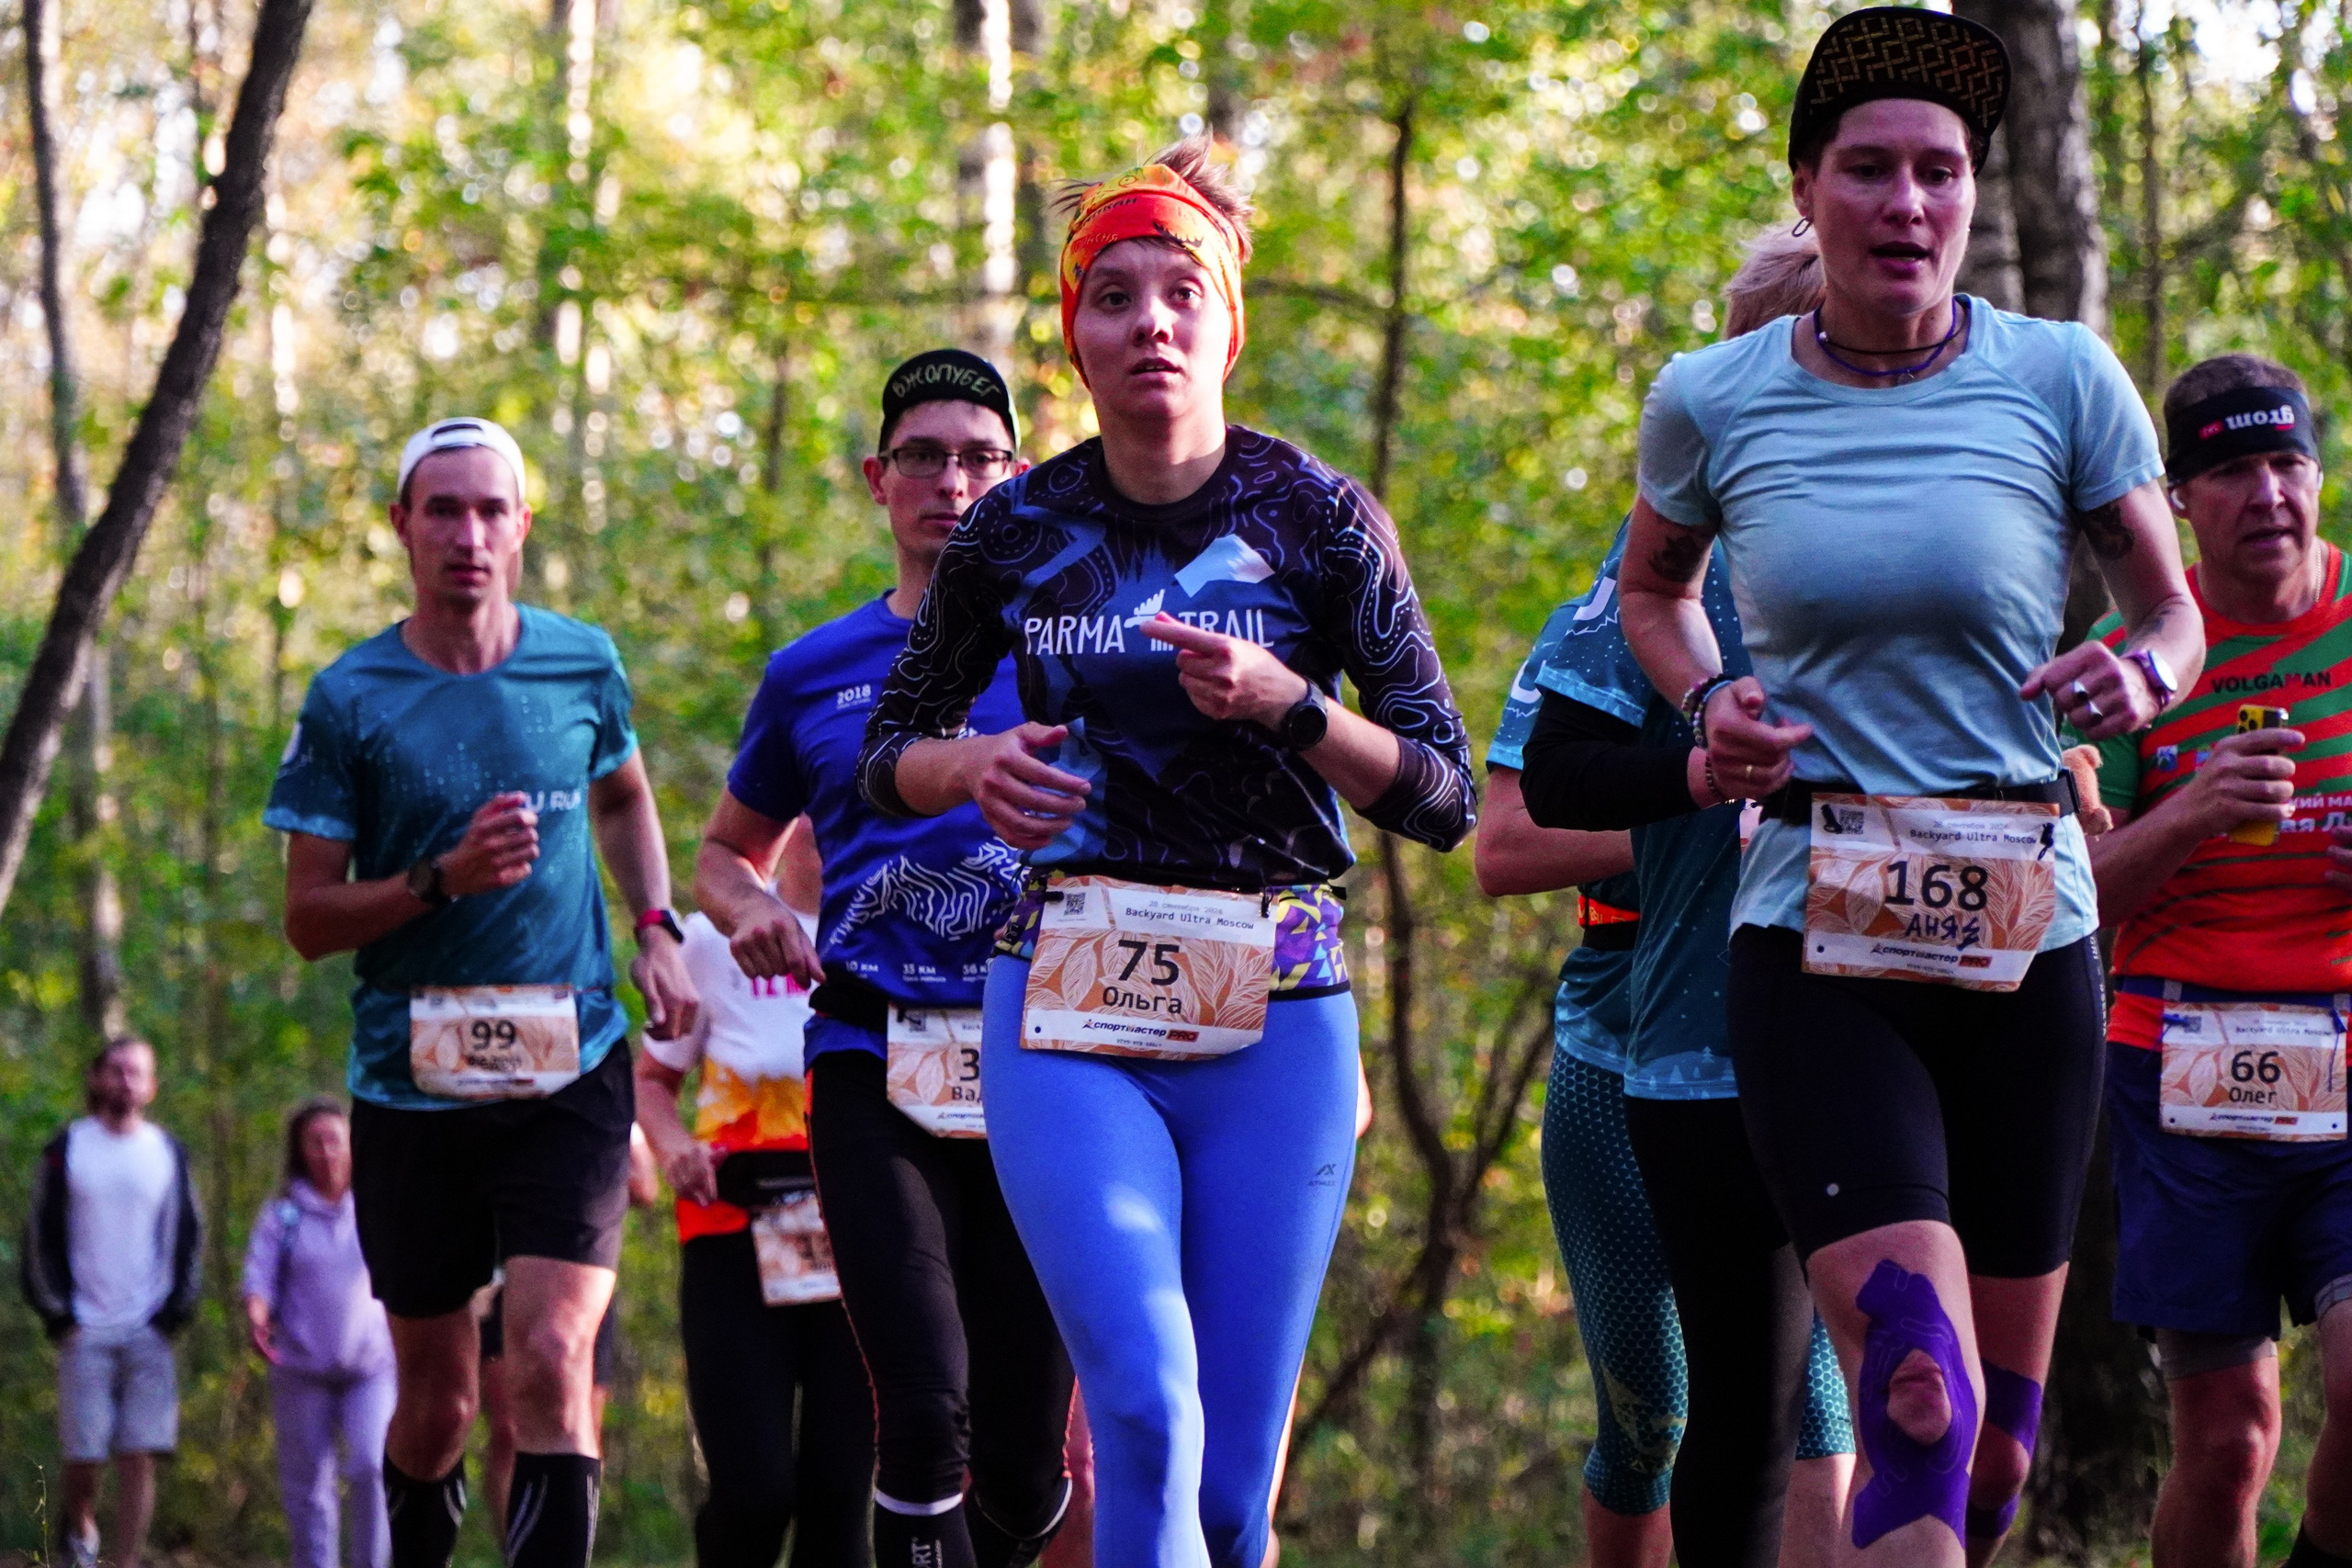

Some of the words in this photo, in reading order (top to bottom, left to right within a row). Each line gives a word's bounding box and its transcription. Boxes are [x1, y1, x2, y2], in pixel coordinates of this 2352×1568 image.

[2225, 404, 2295, 430] grom
[1023, 615, 1125, 655] PARMA
[1178, 609, 1274, 649] TRAIL
[2211, 671, 2332, 693] VOLGAMAN
[837, 683, 871, 705] 2018
[1910, 829, 1962, 841] Backyard
[1966, 832, 1998, 842] Ultra
[2003, 834, 2038, 844] Moscow
[1884, 861, 1988, 911] 168
[1125, 908, 1175, 920] Backyard
[1181, 913, 1211, 924] Ultra
[1216, 919, 1254, 930] Moscow
[1118, 939, 1180, 986] 75
[1883, 946, 1959, 964] спортмастер
[1102, 987, 1182, 1015] Ольга
[471, 1020, 515, 1049] 99
[1093, 1021, 1167, 1037] спортмастер
[1167, 1029, 1199, 1043] PRO
[2231, 1050, 2281, 1083] 66
[952, 1086, 981, 1103] Ва
[2229, 1087, 2277, 1103] Олег
